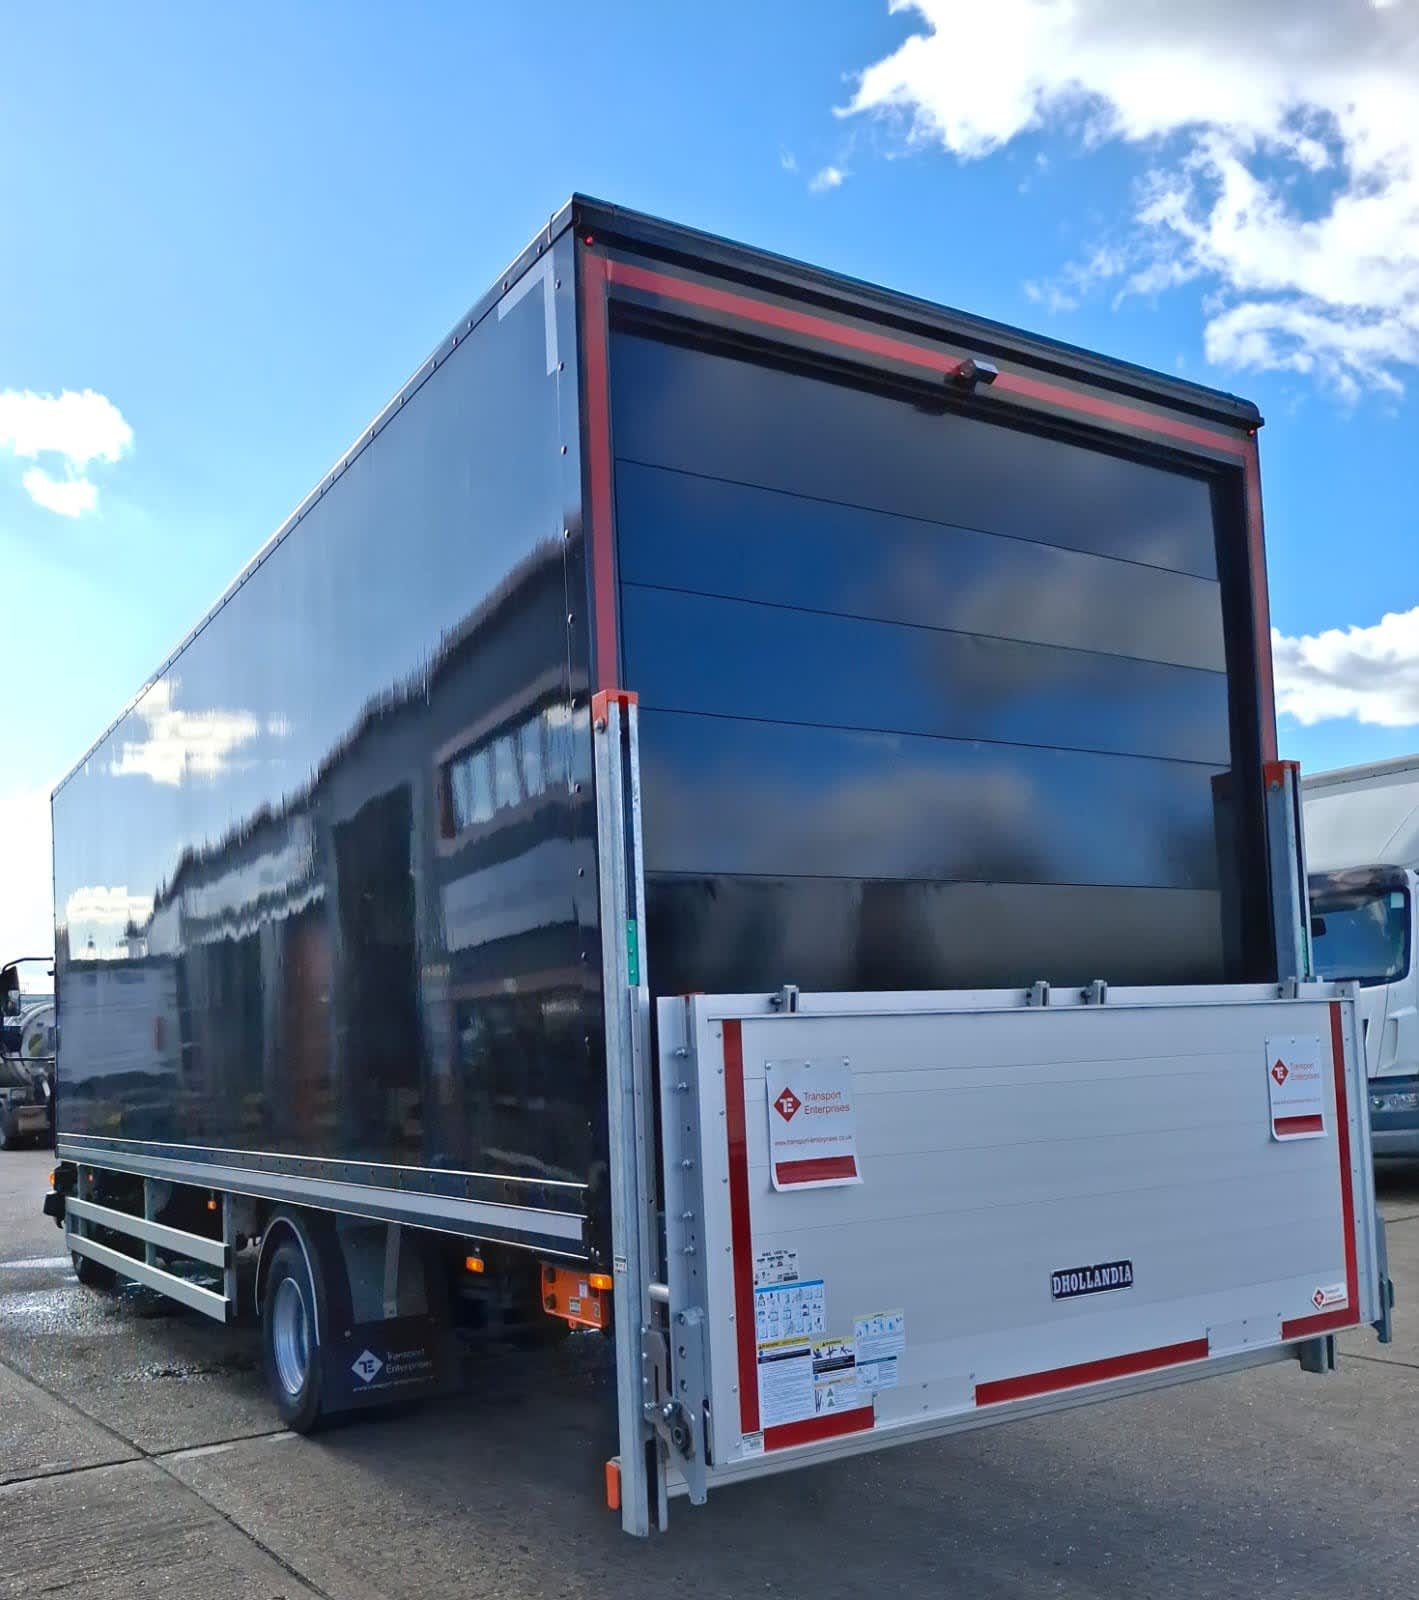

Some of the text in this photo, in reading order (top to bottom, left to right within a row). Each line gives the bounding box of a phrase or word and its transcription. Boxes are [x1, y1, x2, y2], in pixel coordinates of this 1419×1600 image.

[803, 1091, 841, 1103] Transport
[804, 1104, 850, 1115] Enterprises
[1052, 1265, 1132, 1295] DHOLLANDIA
